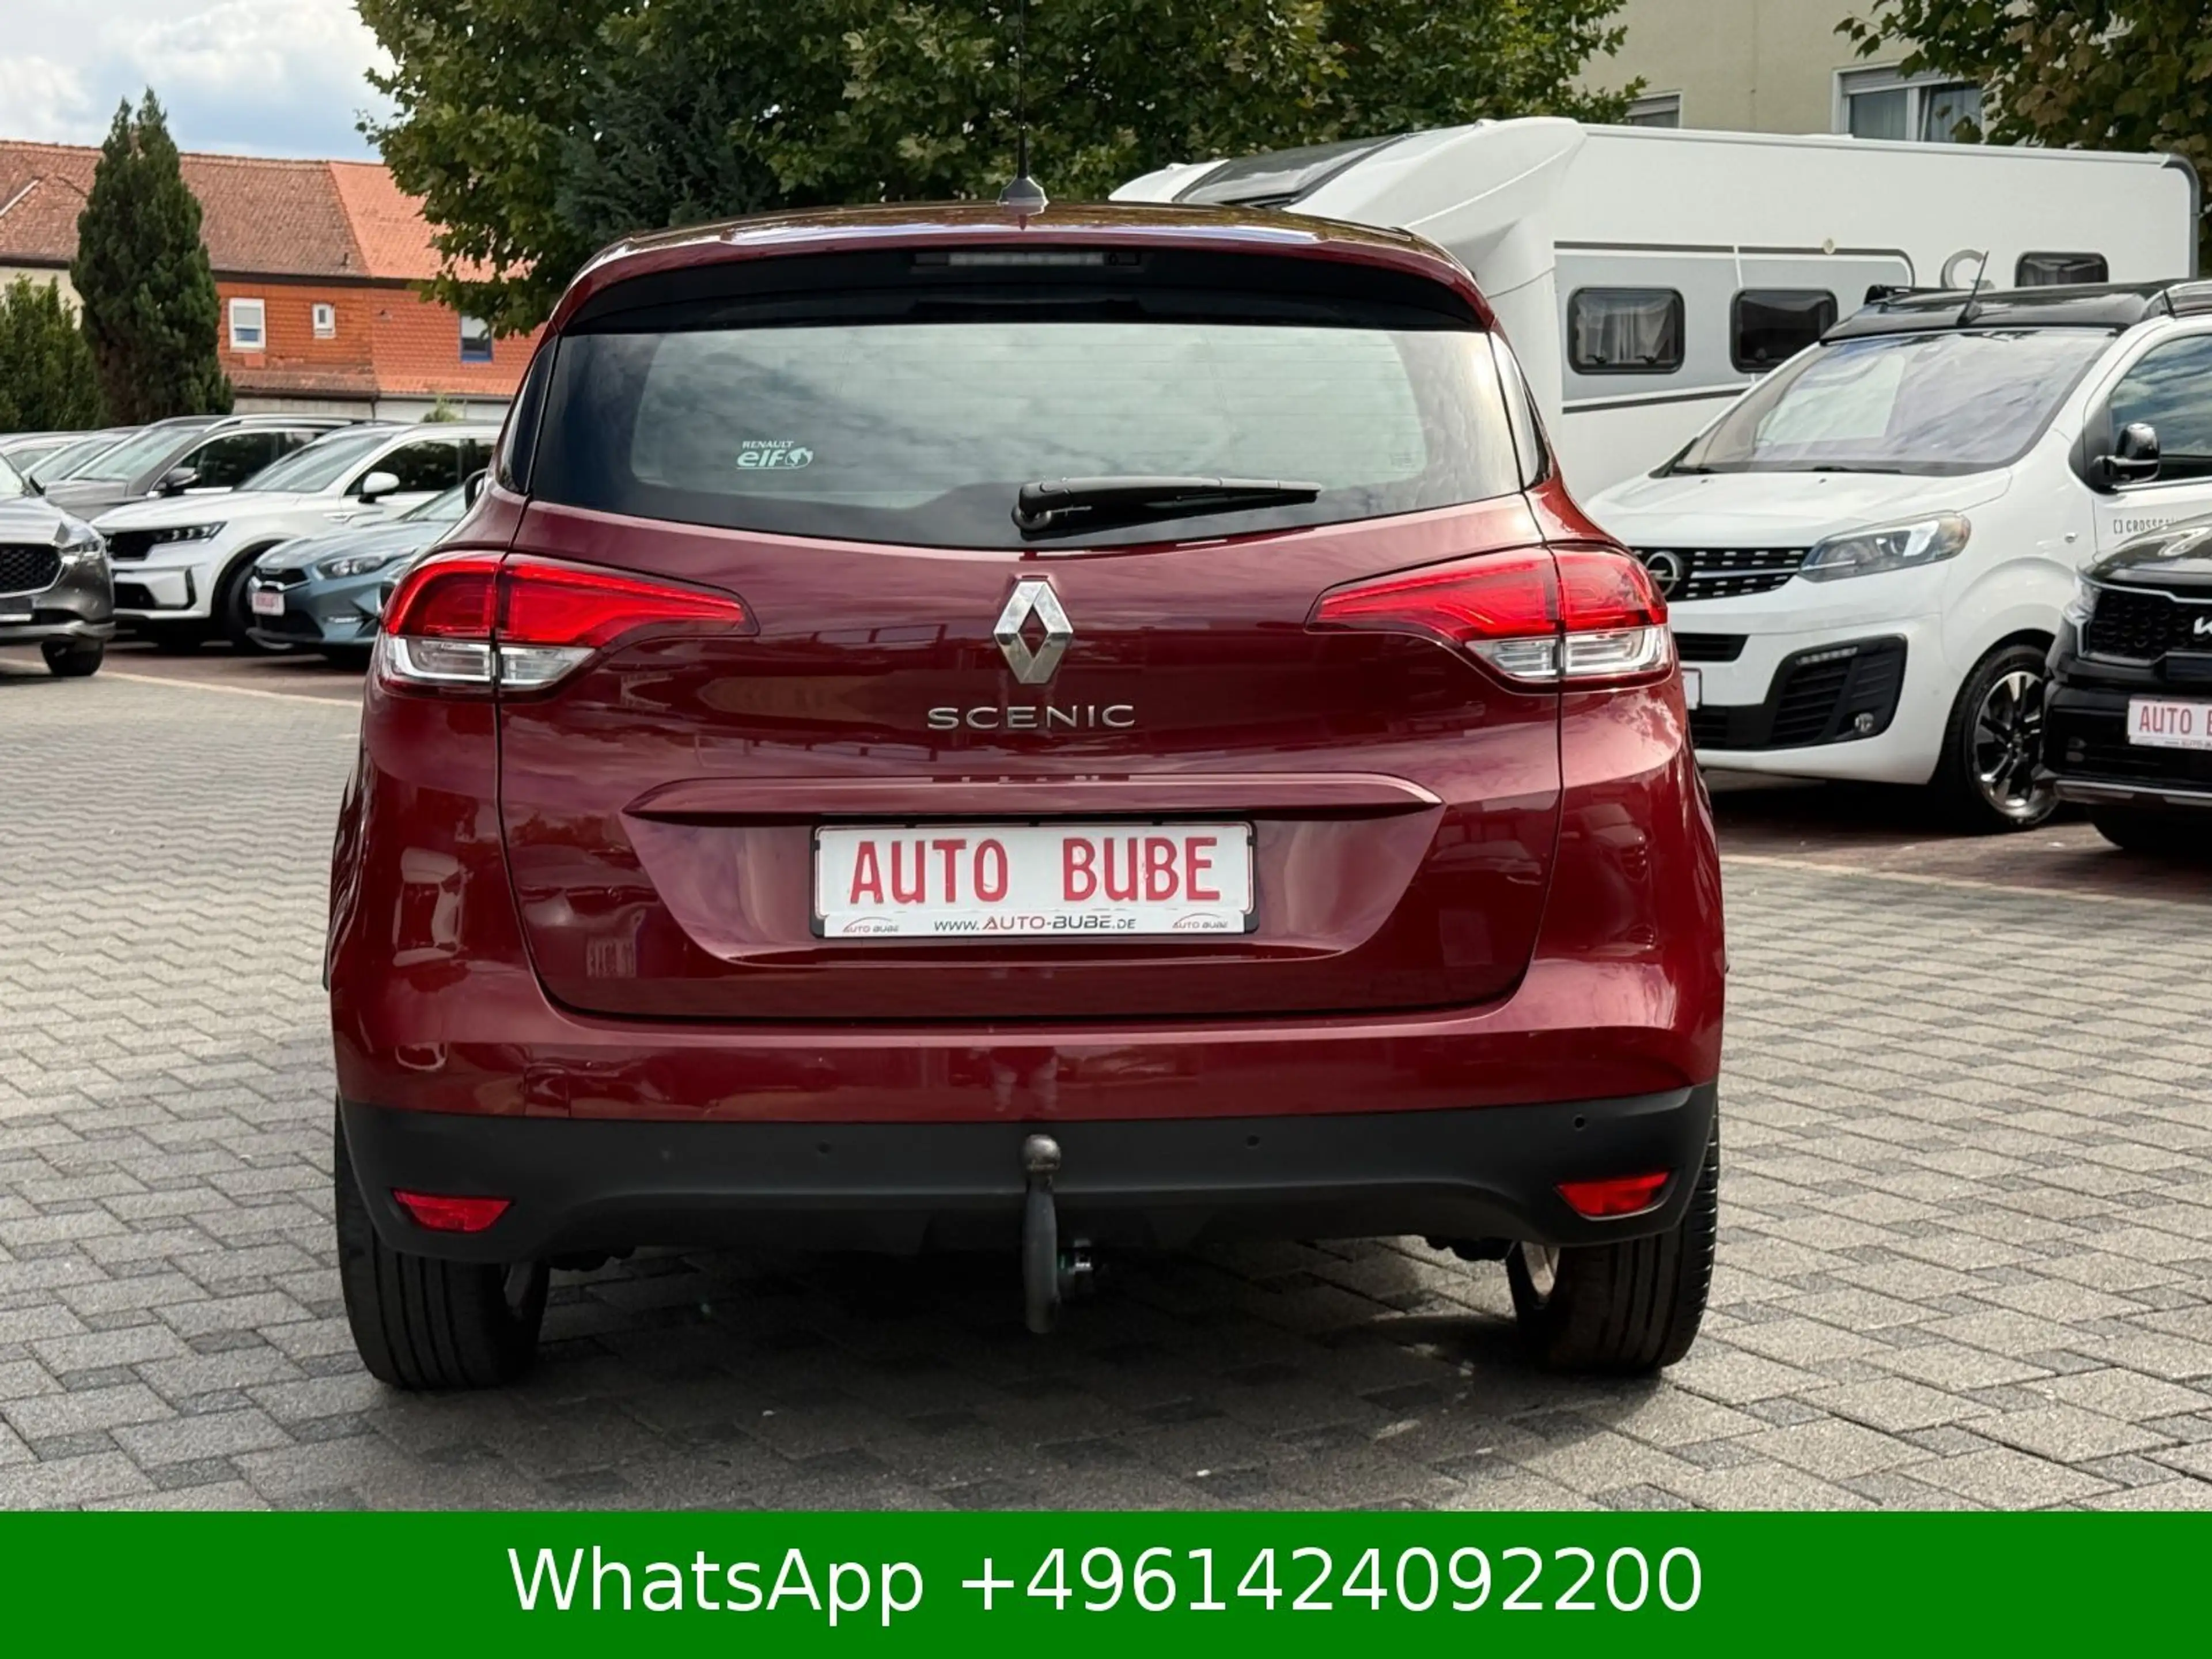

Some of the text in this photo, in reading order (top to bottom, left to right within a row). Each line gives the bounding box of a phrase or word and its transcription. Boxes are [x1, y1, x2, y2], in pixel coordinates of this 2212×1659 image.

[742, 440, 794, 449] RENAULT
[736, 449, 786, 467] elf
[927, 704, 1135, 730] SCENIC
[2139, 705, 2192, 734] AUTO
[850, 837, 1221, 904] AUTO BUBE
